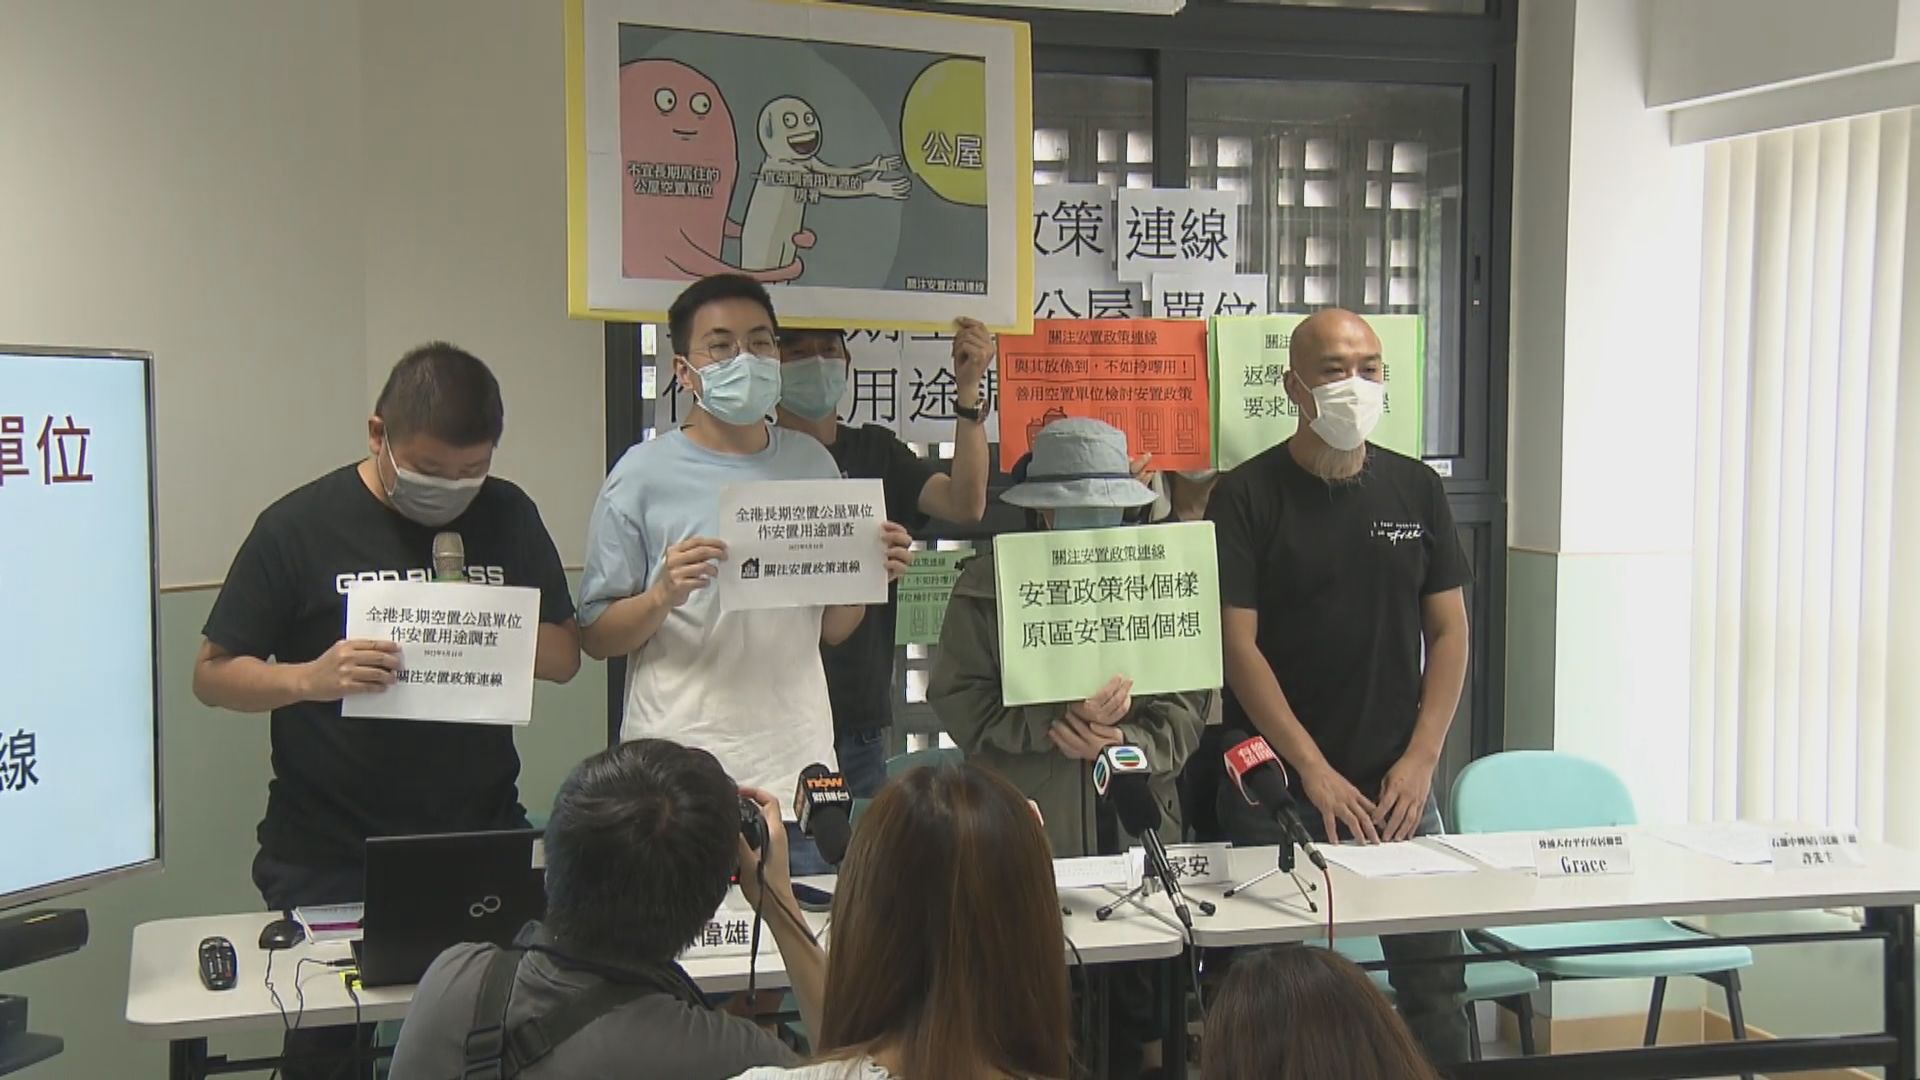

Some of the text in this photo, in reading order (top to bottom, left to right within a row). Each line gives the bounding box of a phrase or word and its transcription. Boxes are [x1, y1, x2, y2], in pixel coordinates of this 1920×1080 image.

[922, 132, 982, 168] 公屋
[627, 161, 720, 183] 不宜長期居住的
[634, 178, 714, 198] 公屋空置單位
[1048, 329, 1158, 346] 關注安置政策連線
[1016, 386, 1194, 402] 善用空置單位檢討安置政策
[735, 504, 874, 523] 全港長期空置公屋單位
[757, 522, 855, 540] 作安置用途調查
[1051, 545, 1166, 566] 關注安置政策連線
[764, 559, 861, 578] 關注安置政策連線
[1019, 571, 1199, 609] 安置政策得個樣
[366, 606, 522, 630] 全港長期空置公屋單位
[390, 628, 499, 647] 作安置用途調查
[1022, 611, 1201, 649] 原區安置個個想
[806, 777, 843, 789] now
[1560, 855, 1609, 874] Grace
